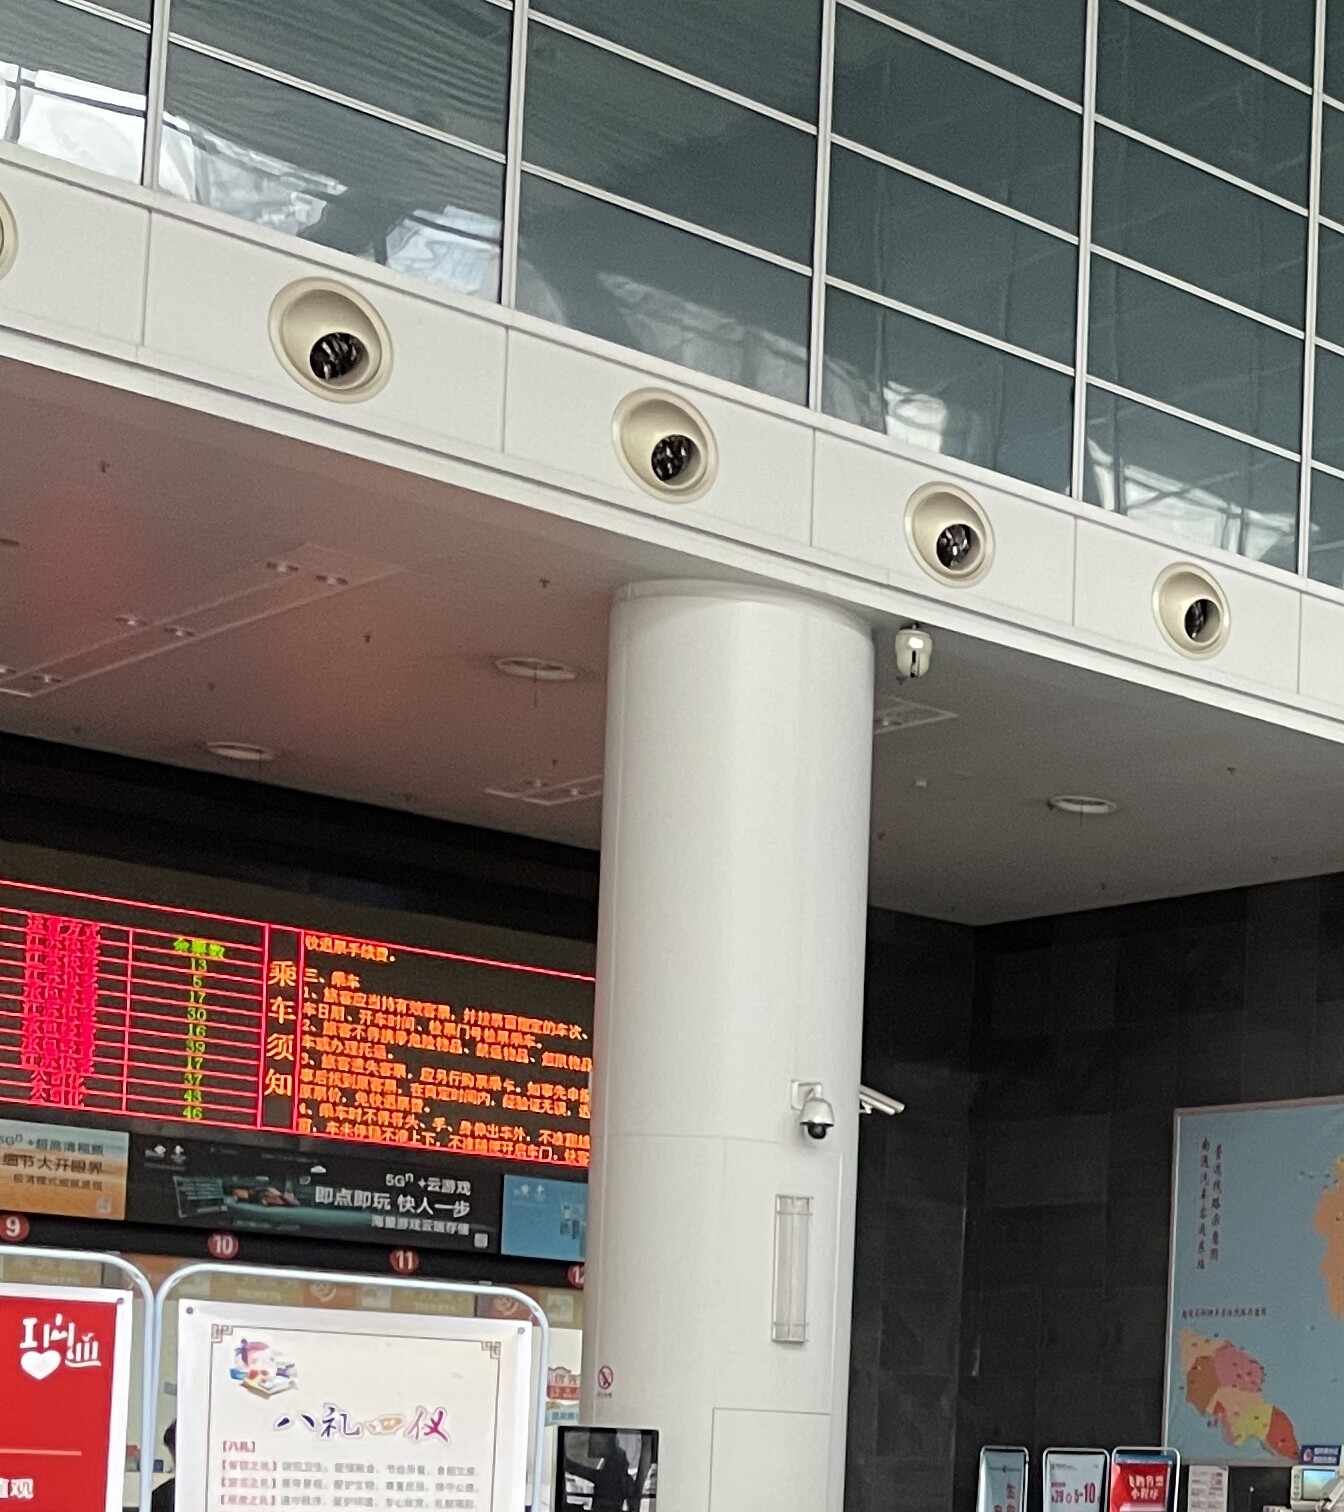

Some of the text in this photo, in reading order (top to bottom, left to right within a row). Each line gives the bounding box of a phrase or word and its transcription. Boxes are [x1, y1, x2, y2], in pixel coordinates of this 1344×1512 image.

[264, 960, 296, 1097] 乘车须知
[314, 1185, 471, 1219] 即点即玩 快人一步
[5, 1216, 20, 1237] 9
[214, 1234, 234, 1254] 10
[397, 1251, 414, 1269] 11
